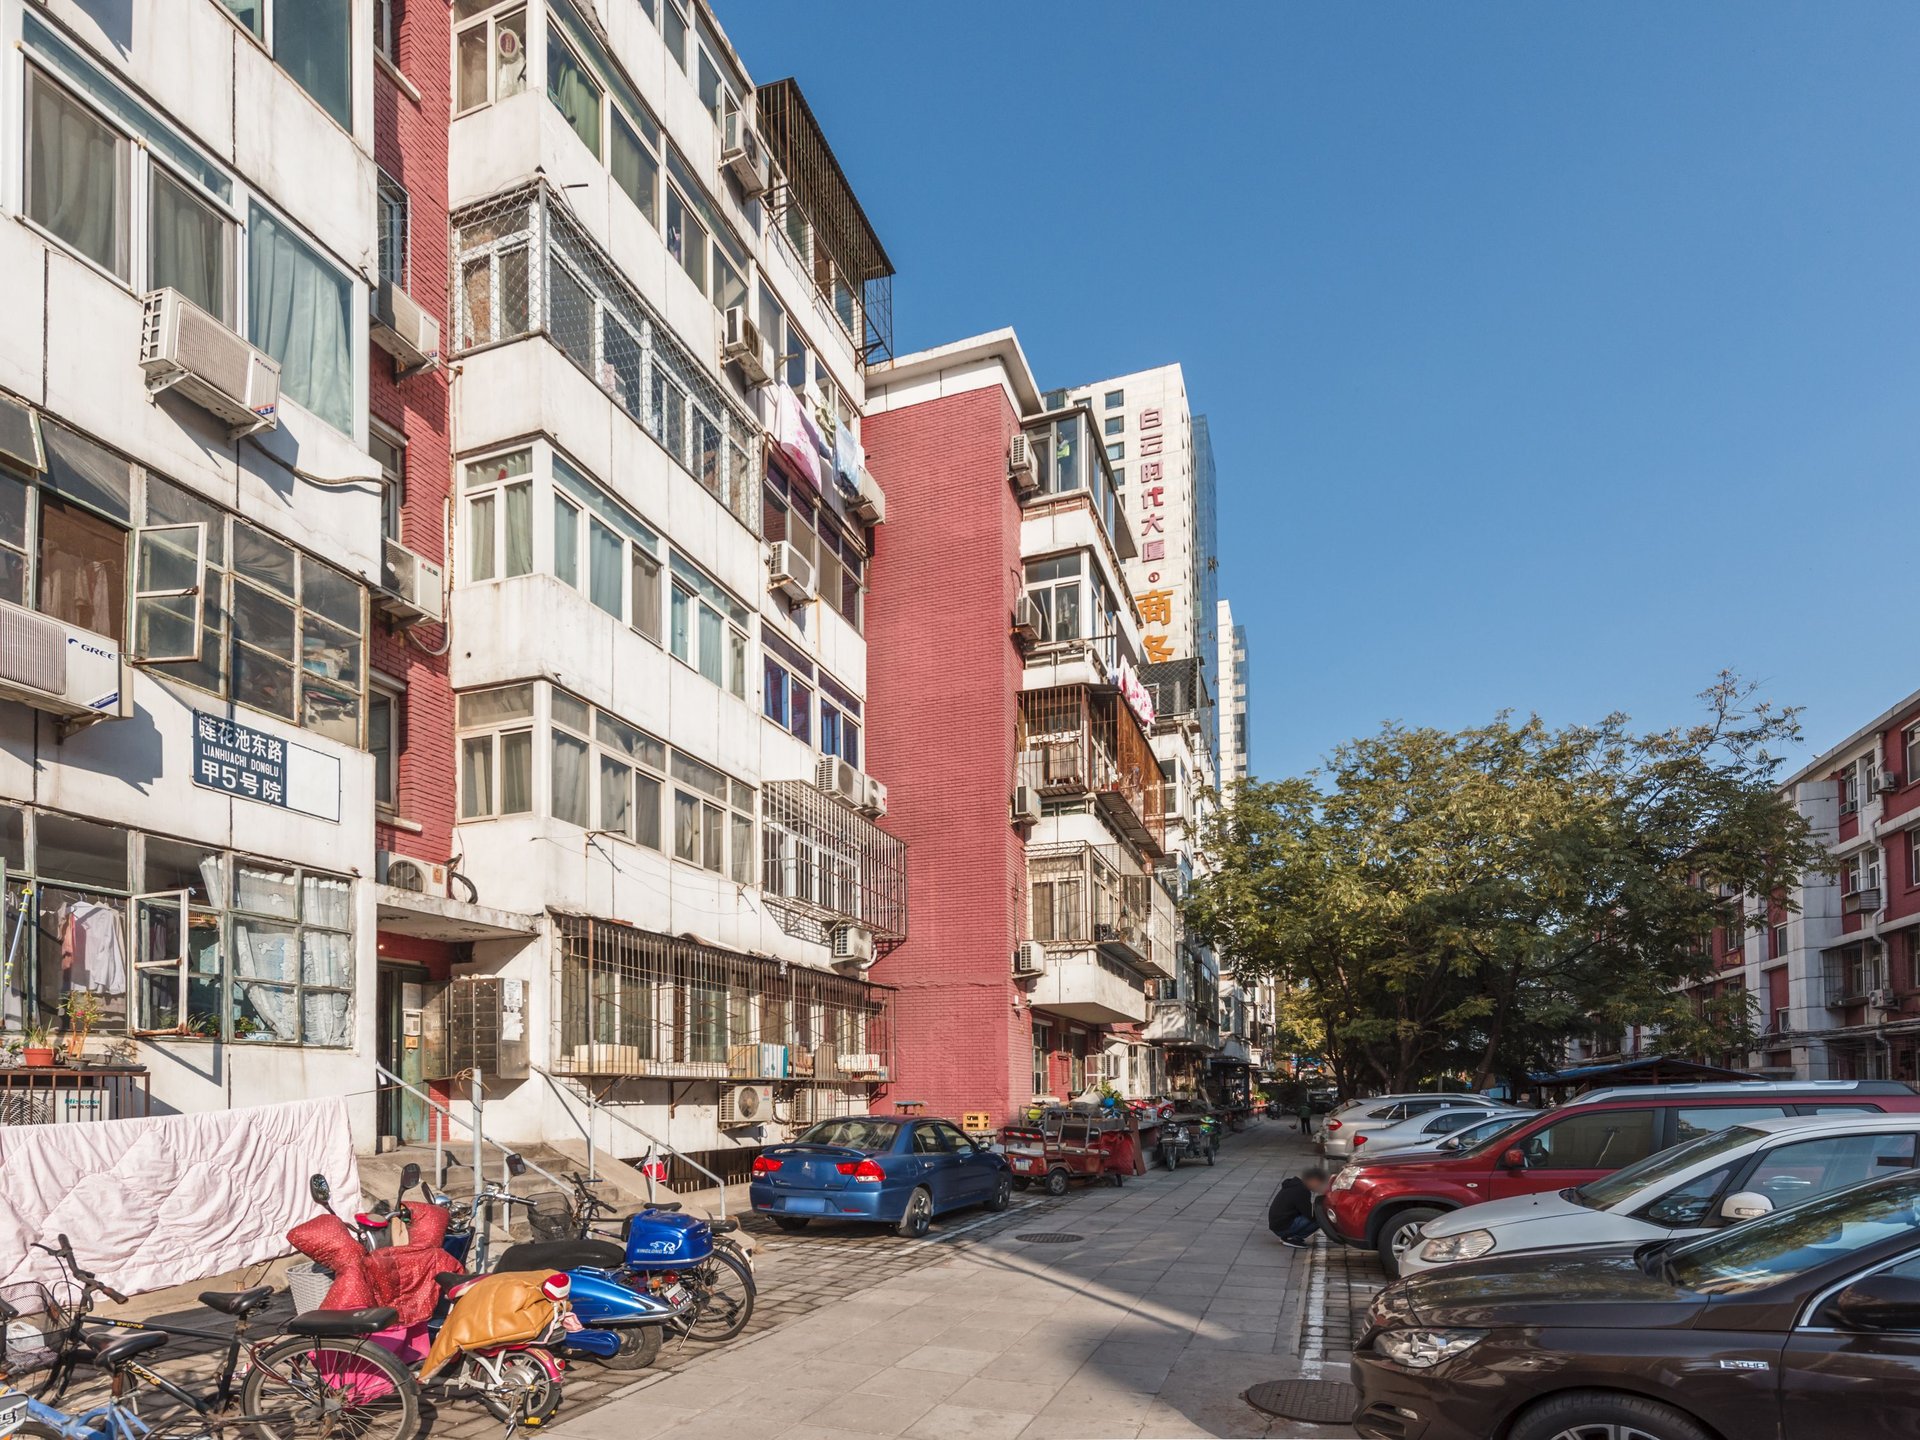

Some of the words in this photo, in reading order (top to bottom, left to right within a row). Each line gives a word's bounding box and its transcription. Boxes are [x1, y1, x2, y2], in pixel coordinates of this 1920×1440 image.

[1140, 408, 1165, 562] 白云时代大厦
[81, 644, 116, 660] GREE
[199, 717, 282, 763] 莲花池东路
[203, 744, 247, 768] LIANHUACHI
[251, 759, 279, 777] DONGLU
[201, 759, 282, 803] 甲5号院
